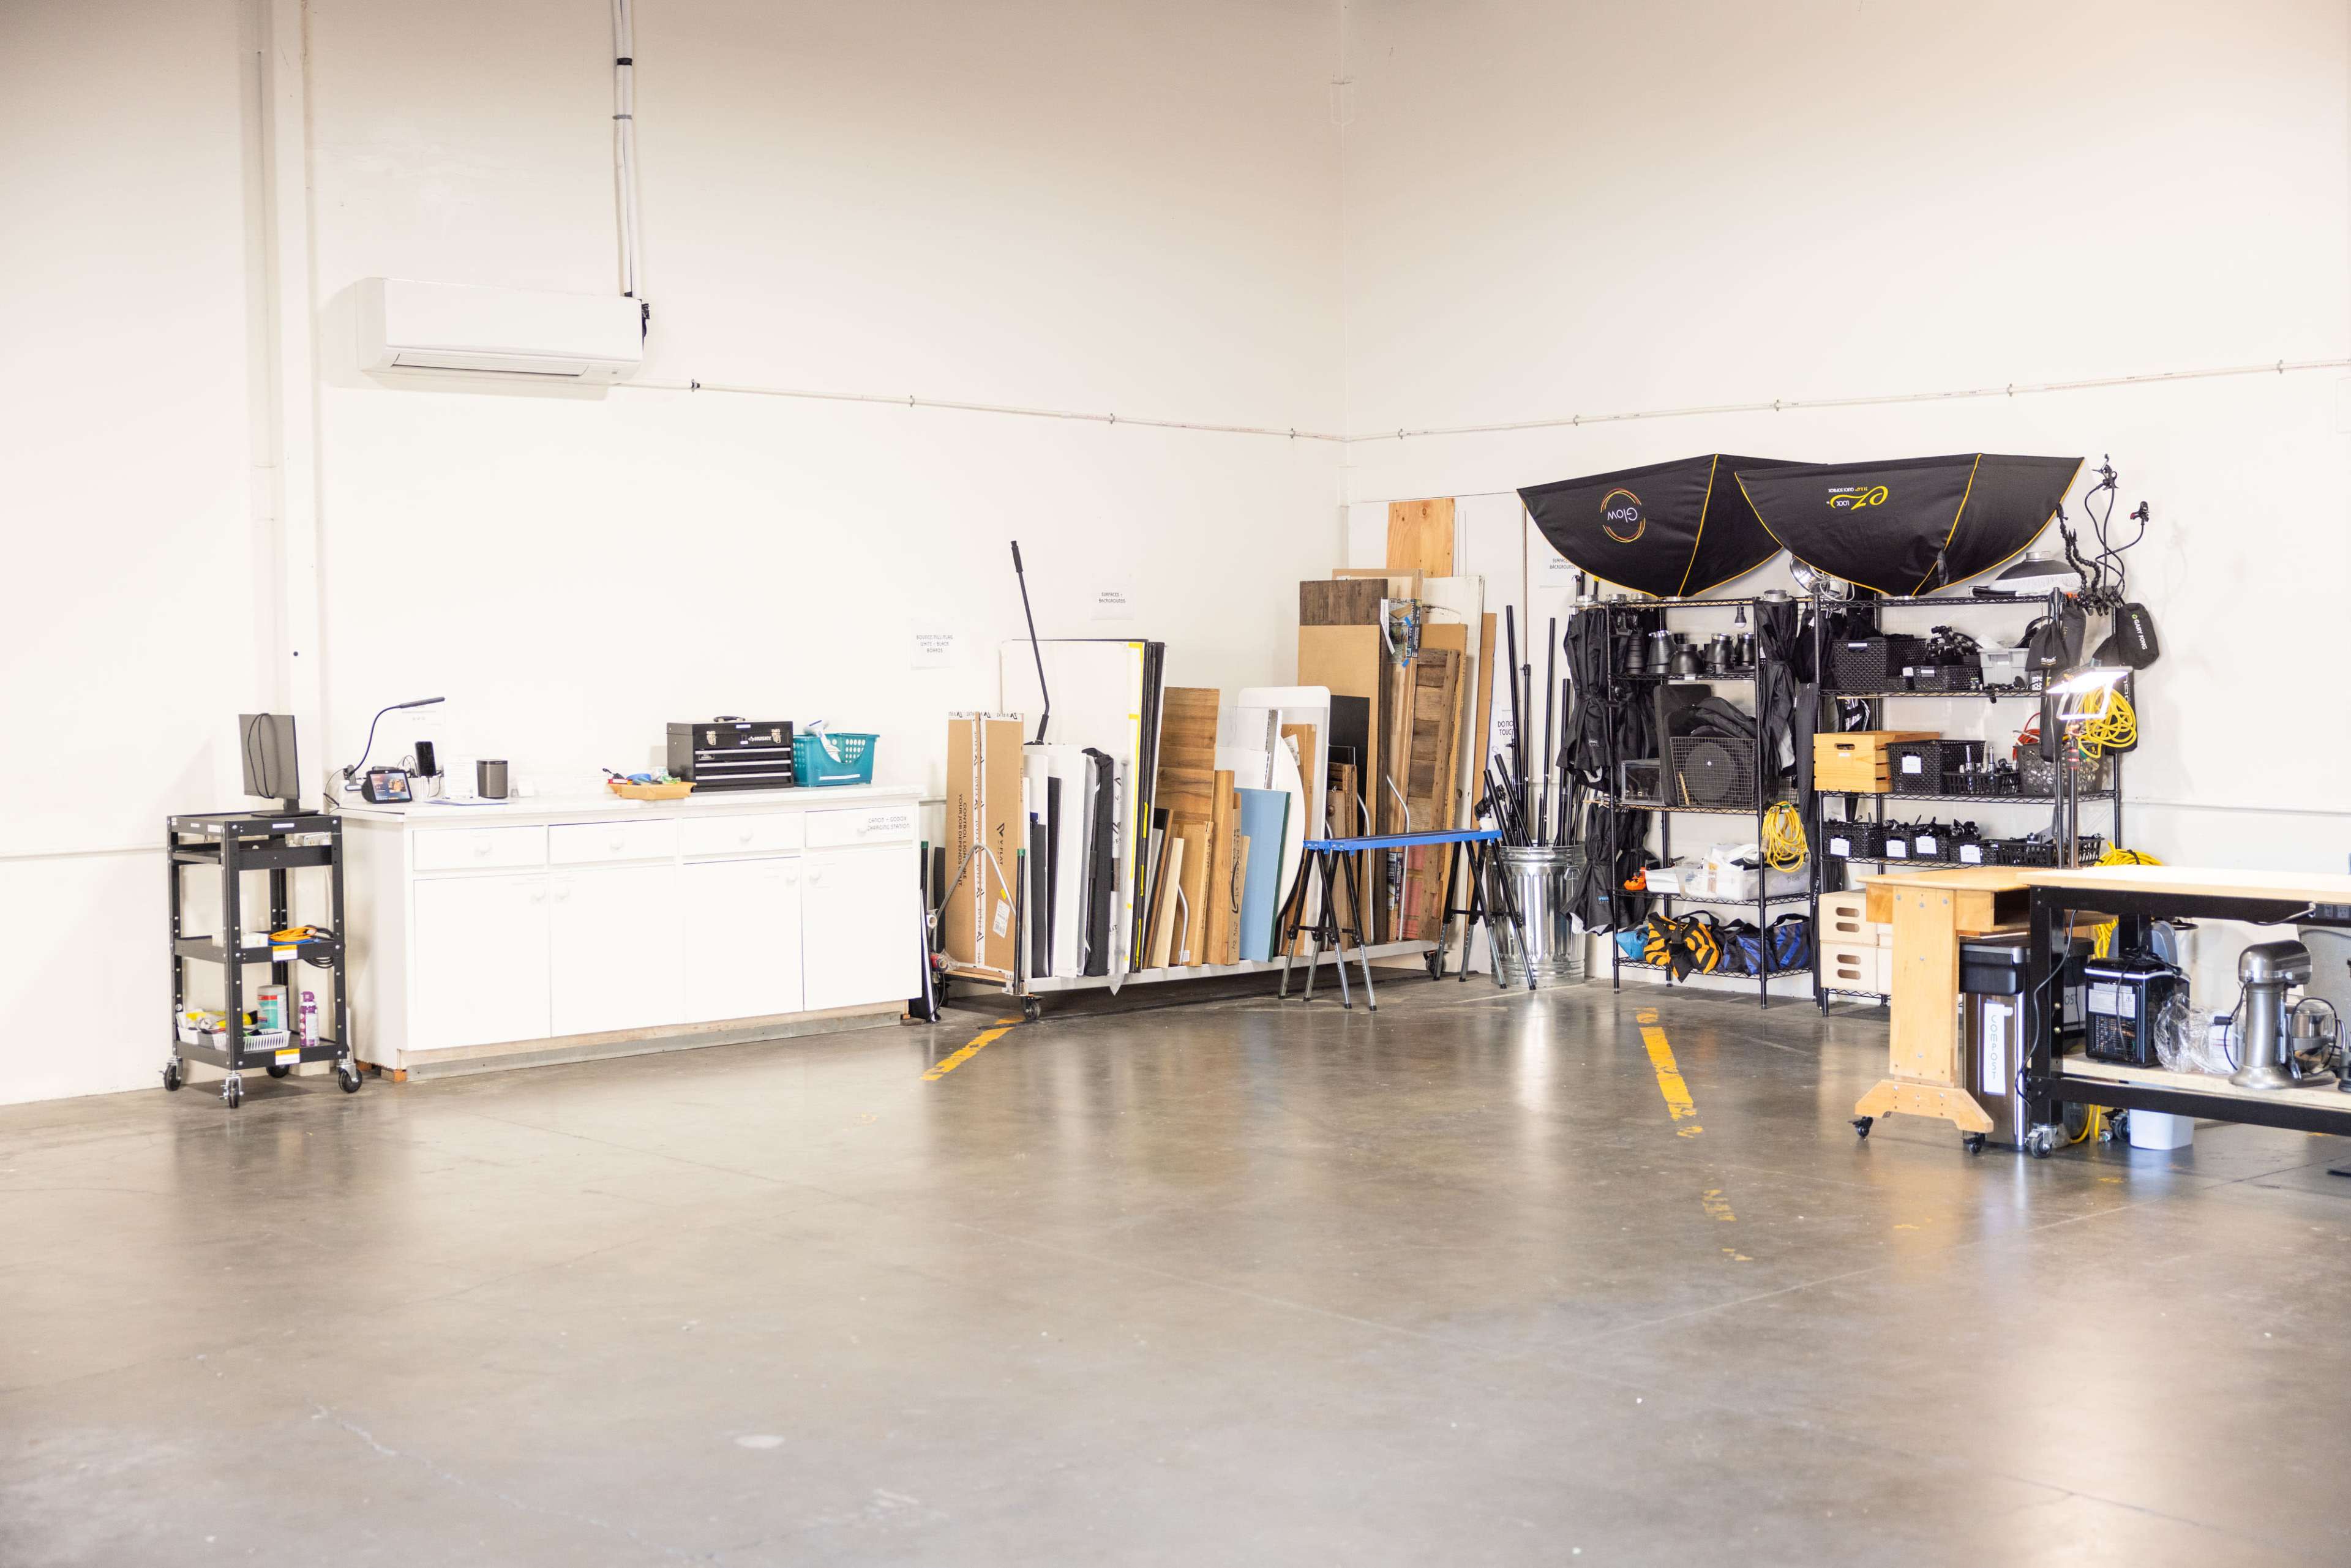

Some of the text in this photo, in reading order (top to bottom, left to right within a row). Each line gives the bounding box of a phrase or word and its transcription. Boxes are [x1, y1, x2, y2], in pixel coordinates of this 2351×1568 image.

[1607, 507, 1638, 523] Glow
[2134, 619, 2148, 650] GARY FONG
[1990, 1015, 1998, 1079] COMPOST
